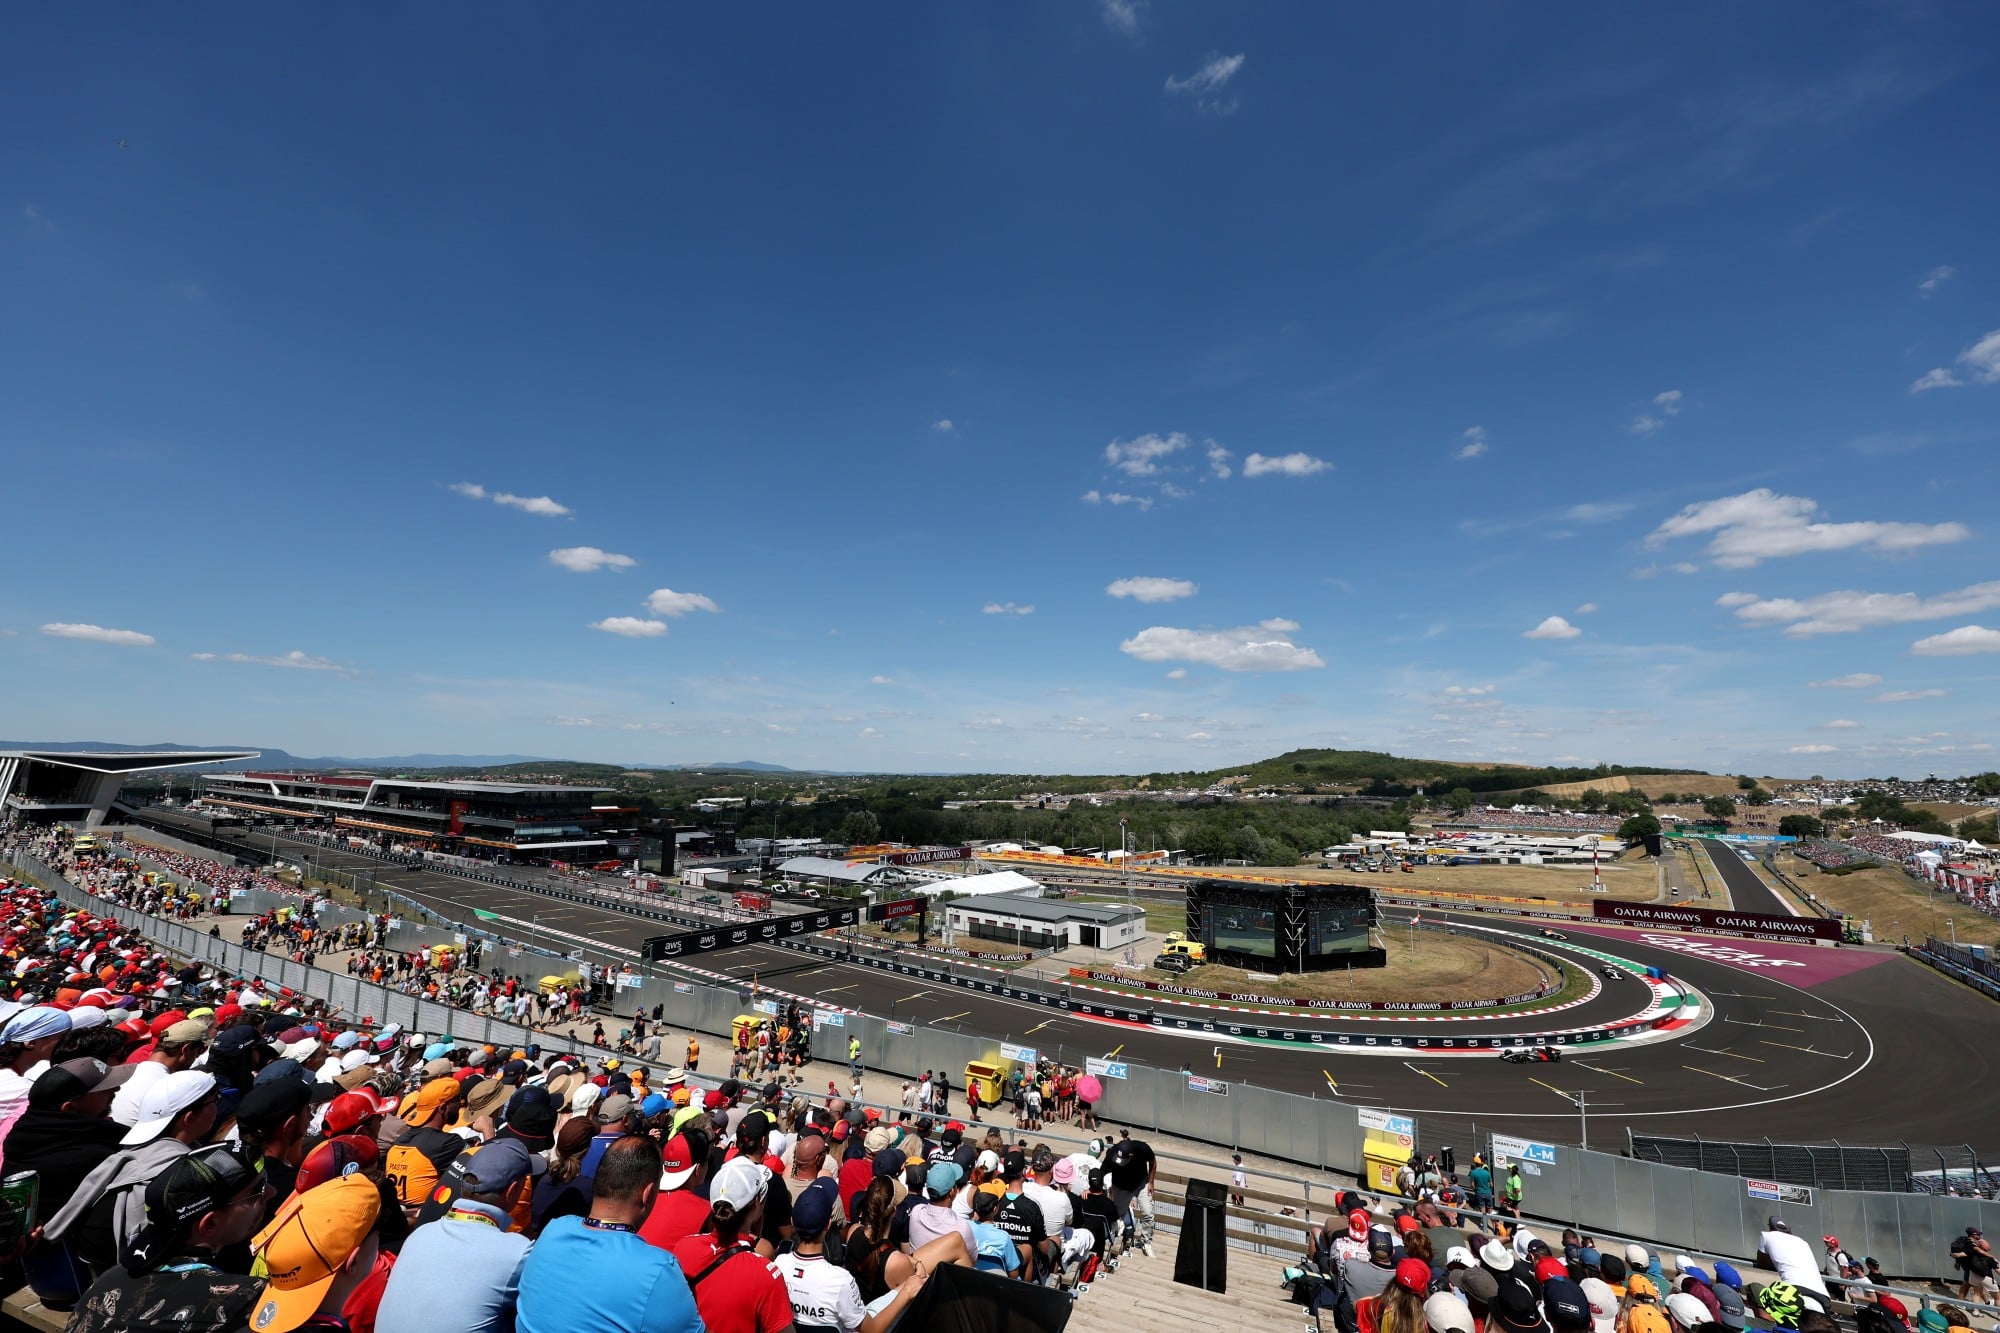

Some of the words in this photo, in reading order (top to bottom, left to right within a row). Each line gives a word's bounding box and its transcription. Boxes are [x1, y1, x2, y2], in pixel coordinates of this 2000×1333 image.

[906, 852, 931, 864] QATAR
[932, 849, 960, 860] AIRWAYS
[888, 904, 912, 915] Lenovo
[841, 912, 853, 921] aws
[1614, 908, 1650, 918] QATAR
[1653, 911, 1701, 922] AIRWAYS
[790, 920, 804, 930] aws
[817, 916, 829, 925] aws
[1716, 917, 1757, 928] QATAR
[1760, 921, 1815, 933] AIRWAYS
[762, 925, 776, 934] aws
[700, 935, 716, 945] aws
[732, 930, 747, 940] aws
[665, 940, 682, 951] aws
[926, 945, 944, 953] QATAR
[946, 948, 969, 957] AIRWAYS
[1093, 972, 1116, 982] QATAR
[1116, 976, 1146, 988] AIRWAYS
[1157, 985, 1184, 994] QATAR
[1184, 987, 1218, 998] AIRWAYS
[1231, 994, 1258, 1002] QATAR
[1260, 996, 1295, 1006] AIRWAYS
[1520, 993, 1537, 1002] AIRWAYS
[1308, 1000, 1336, 1008] QATAR
[1474, 1000, 1498, 1008] AIRWAYS
[831, 1016, 844, 1025] G-H
[1020, 1052, 1035, 1062] J-K
[1110, 1066, 1126, 1076] J-K
[1390, 1121, 1411, 1134] L-M
[1529, 1148, 1553, 1160] L-M
[346, 1163, 356, 1174] hp
[1750, 1182, 1776, 1190] CAUTION
[791, 1302, 825, 1317] RONAS
